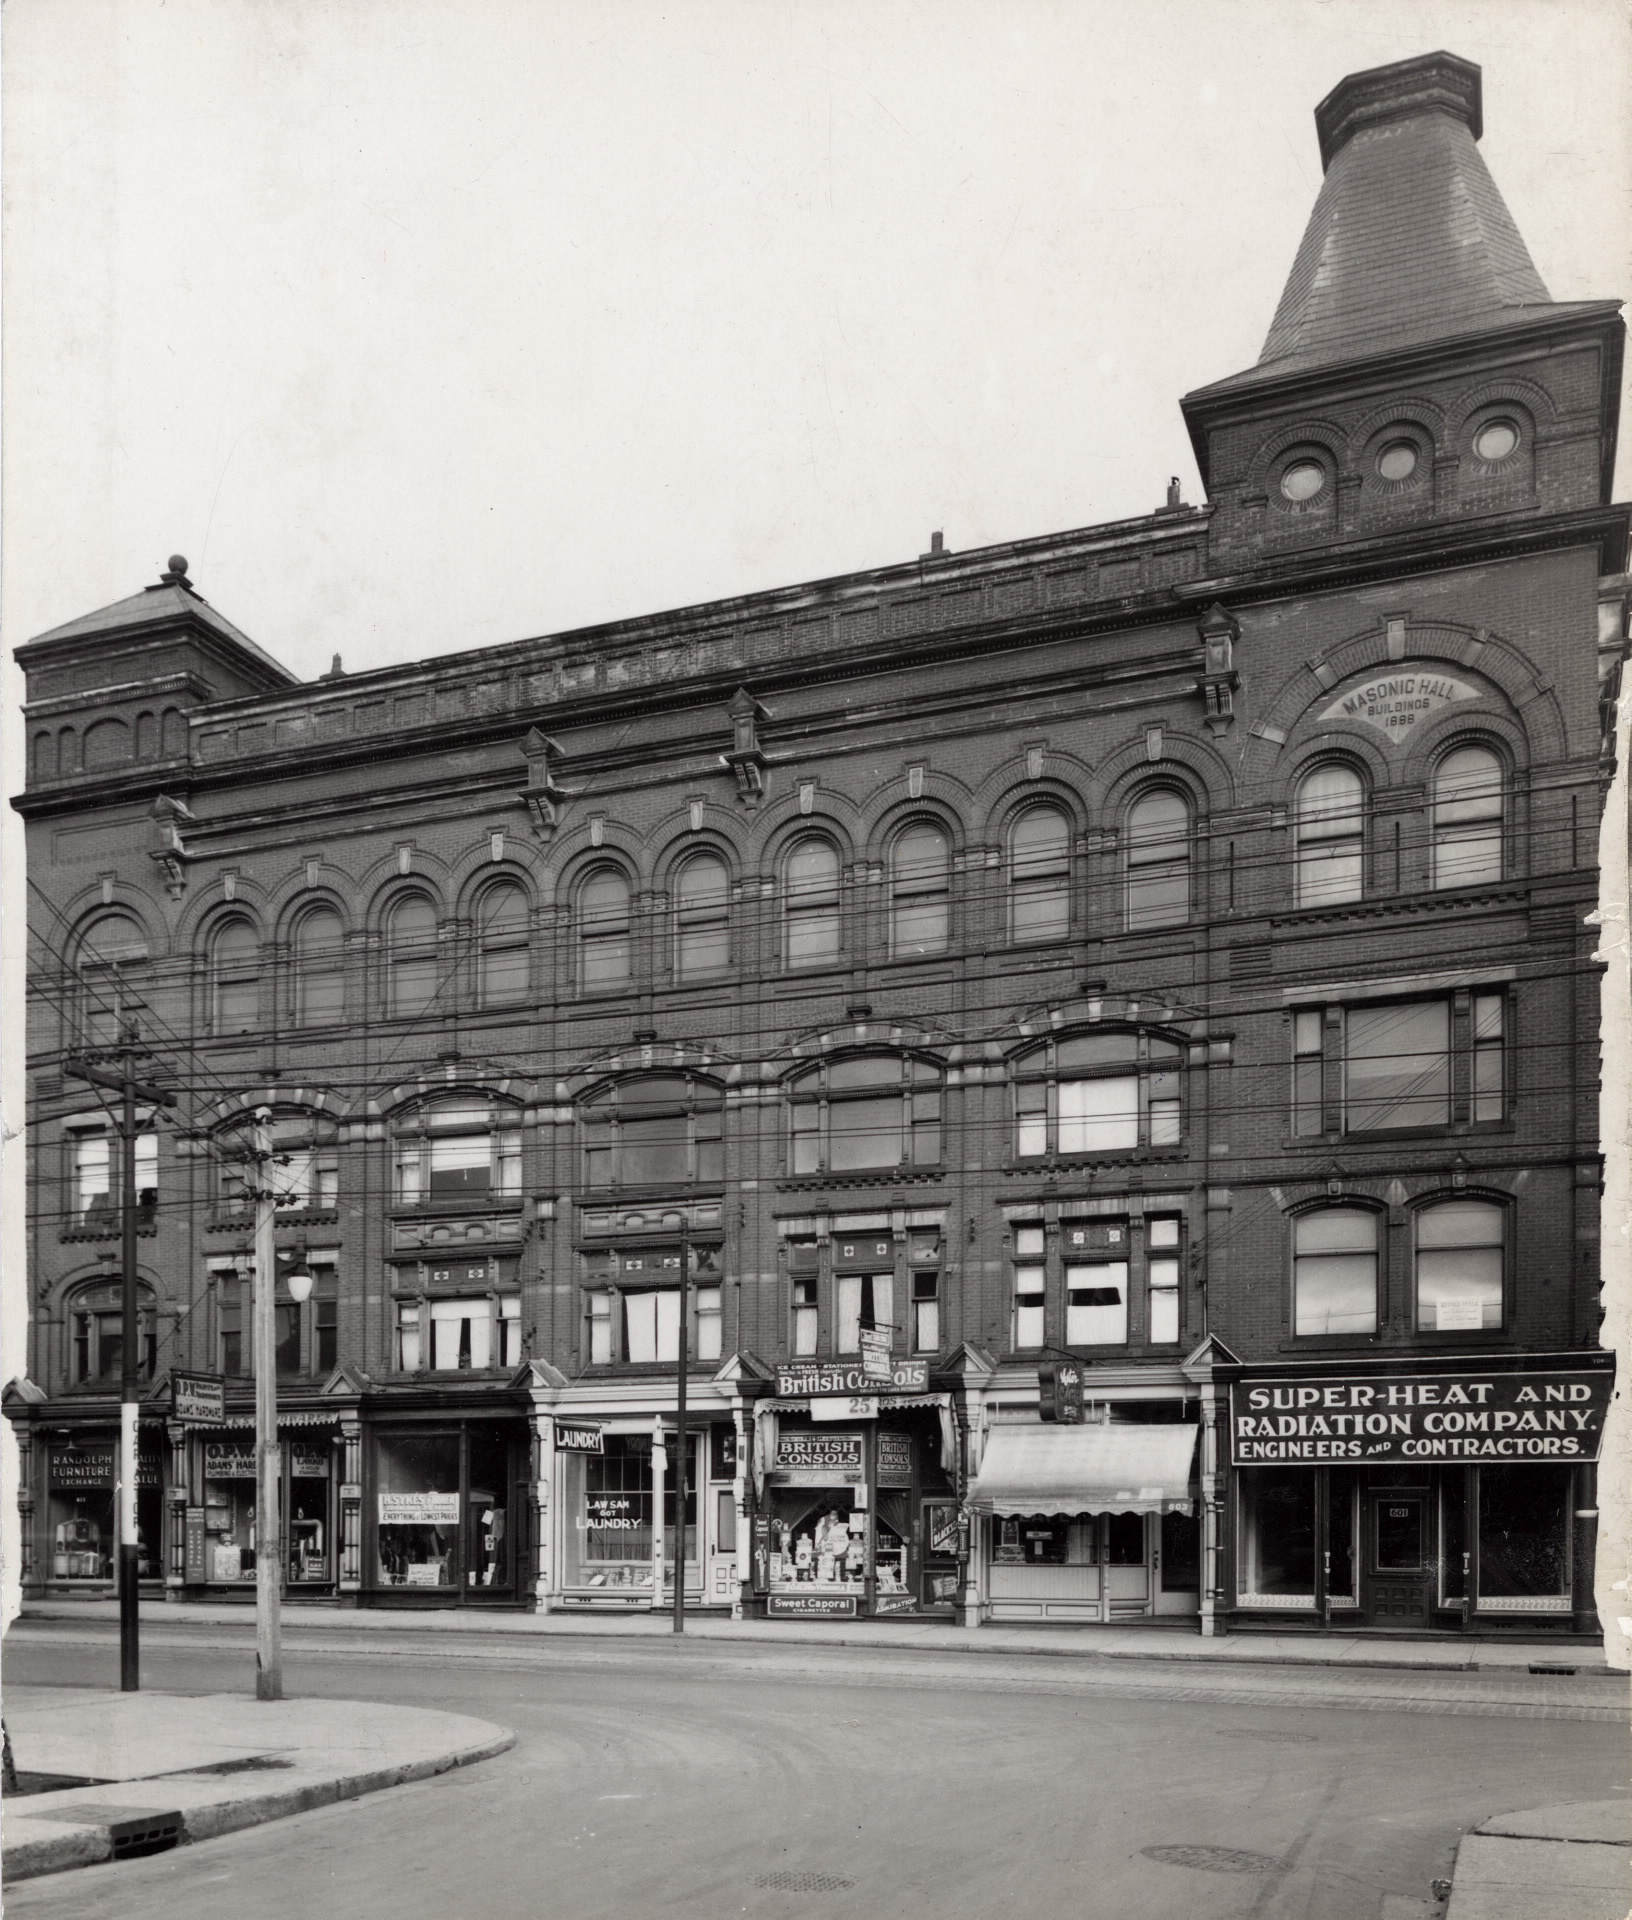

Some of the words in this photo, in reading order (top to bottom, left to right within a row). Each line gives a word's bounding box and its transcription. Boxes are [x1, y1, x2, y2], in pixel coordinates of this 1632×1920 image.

[1342, 679, 1415, 715] MASONIC
[1419, 679, 1454, 700] HALL
[1367, 698, 1430, 716] BUILDINGS
[1385, 714, 1415, 727] 1888
[778, 1373, 846, 1395] British
[1248, 1383, 1495, 1411] SUPER-HEAT
[1514, 1384, 1593, 1404] AND
[1236, 1412, 1414, 1438] RADIATION
[1422, 1408, 1599, 1434] COMPANY.
[556, 1427, 601, 1449] LAUNDRY
[207, 1444, 256, 1459] O.P.W.
[780, 1442, 856, 1453] BRITISH
[881, 1442, 908, 1453] BRITISH
[1238, 1440, 1364, 1459] ENGINEERS
[1366, 1441, 1393, 1457] AND
[1401, 1436, 1587, 1457] CONTRACTORS.
[53, 1455, 113, 1465] RANDOLPH
[776, 1453, 859, 1464] CONSOLS
[881, 1453, 909, 1464] CONSOLS
[52, 1466, 112, 1477] FURNITURE
[60, 1478, 102, 1486] EXCHANGE
[135, 1475, 159, 1484] ALUE
[586, 1500, 609, 1509] LAW
[609, 1500, 630, 1509] SAM
[1168, 1503, 1188, 1511] 603
[383, 1512, 416, 1521] EVERYTHING
[421, 1512, 440, 1521] LOWEST
[440, 1511, 458, 1521] PRICES
[1390, 1508, 1408, 1517] 601
[576, 1516, 642, 1530] LAUNDRY
[774, 1598, 807, 1608] Sweet
[807, 1598, 850, 1609] Caporal
